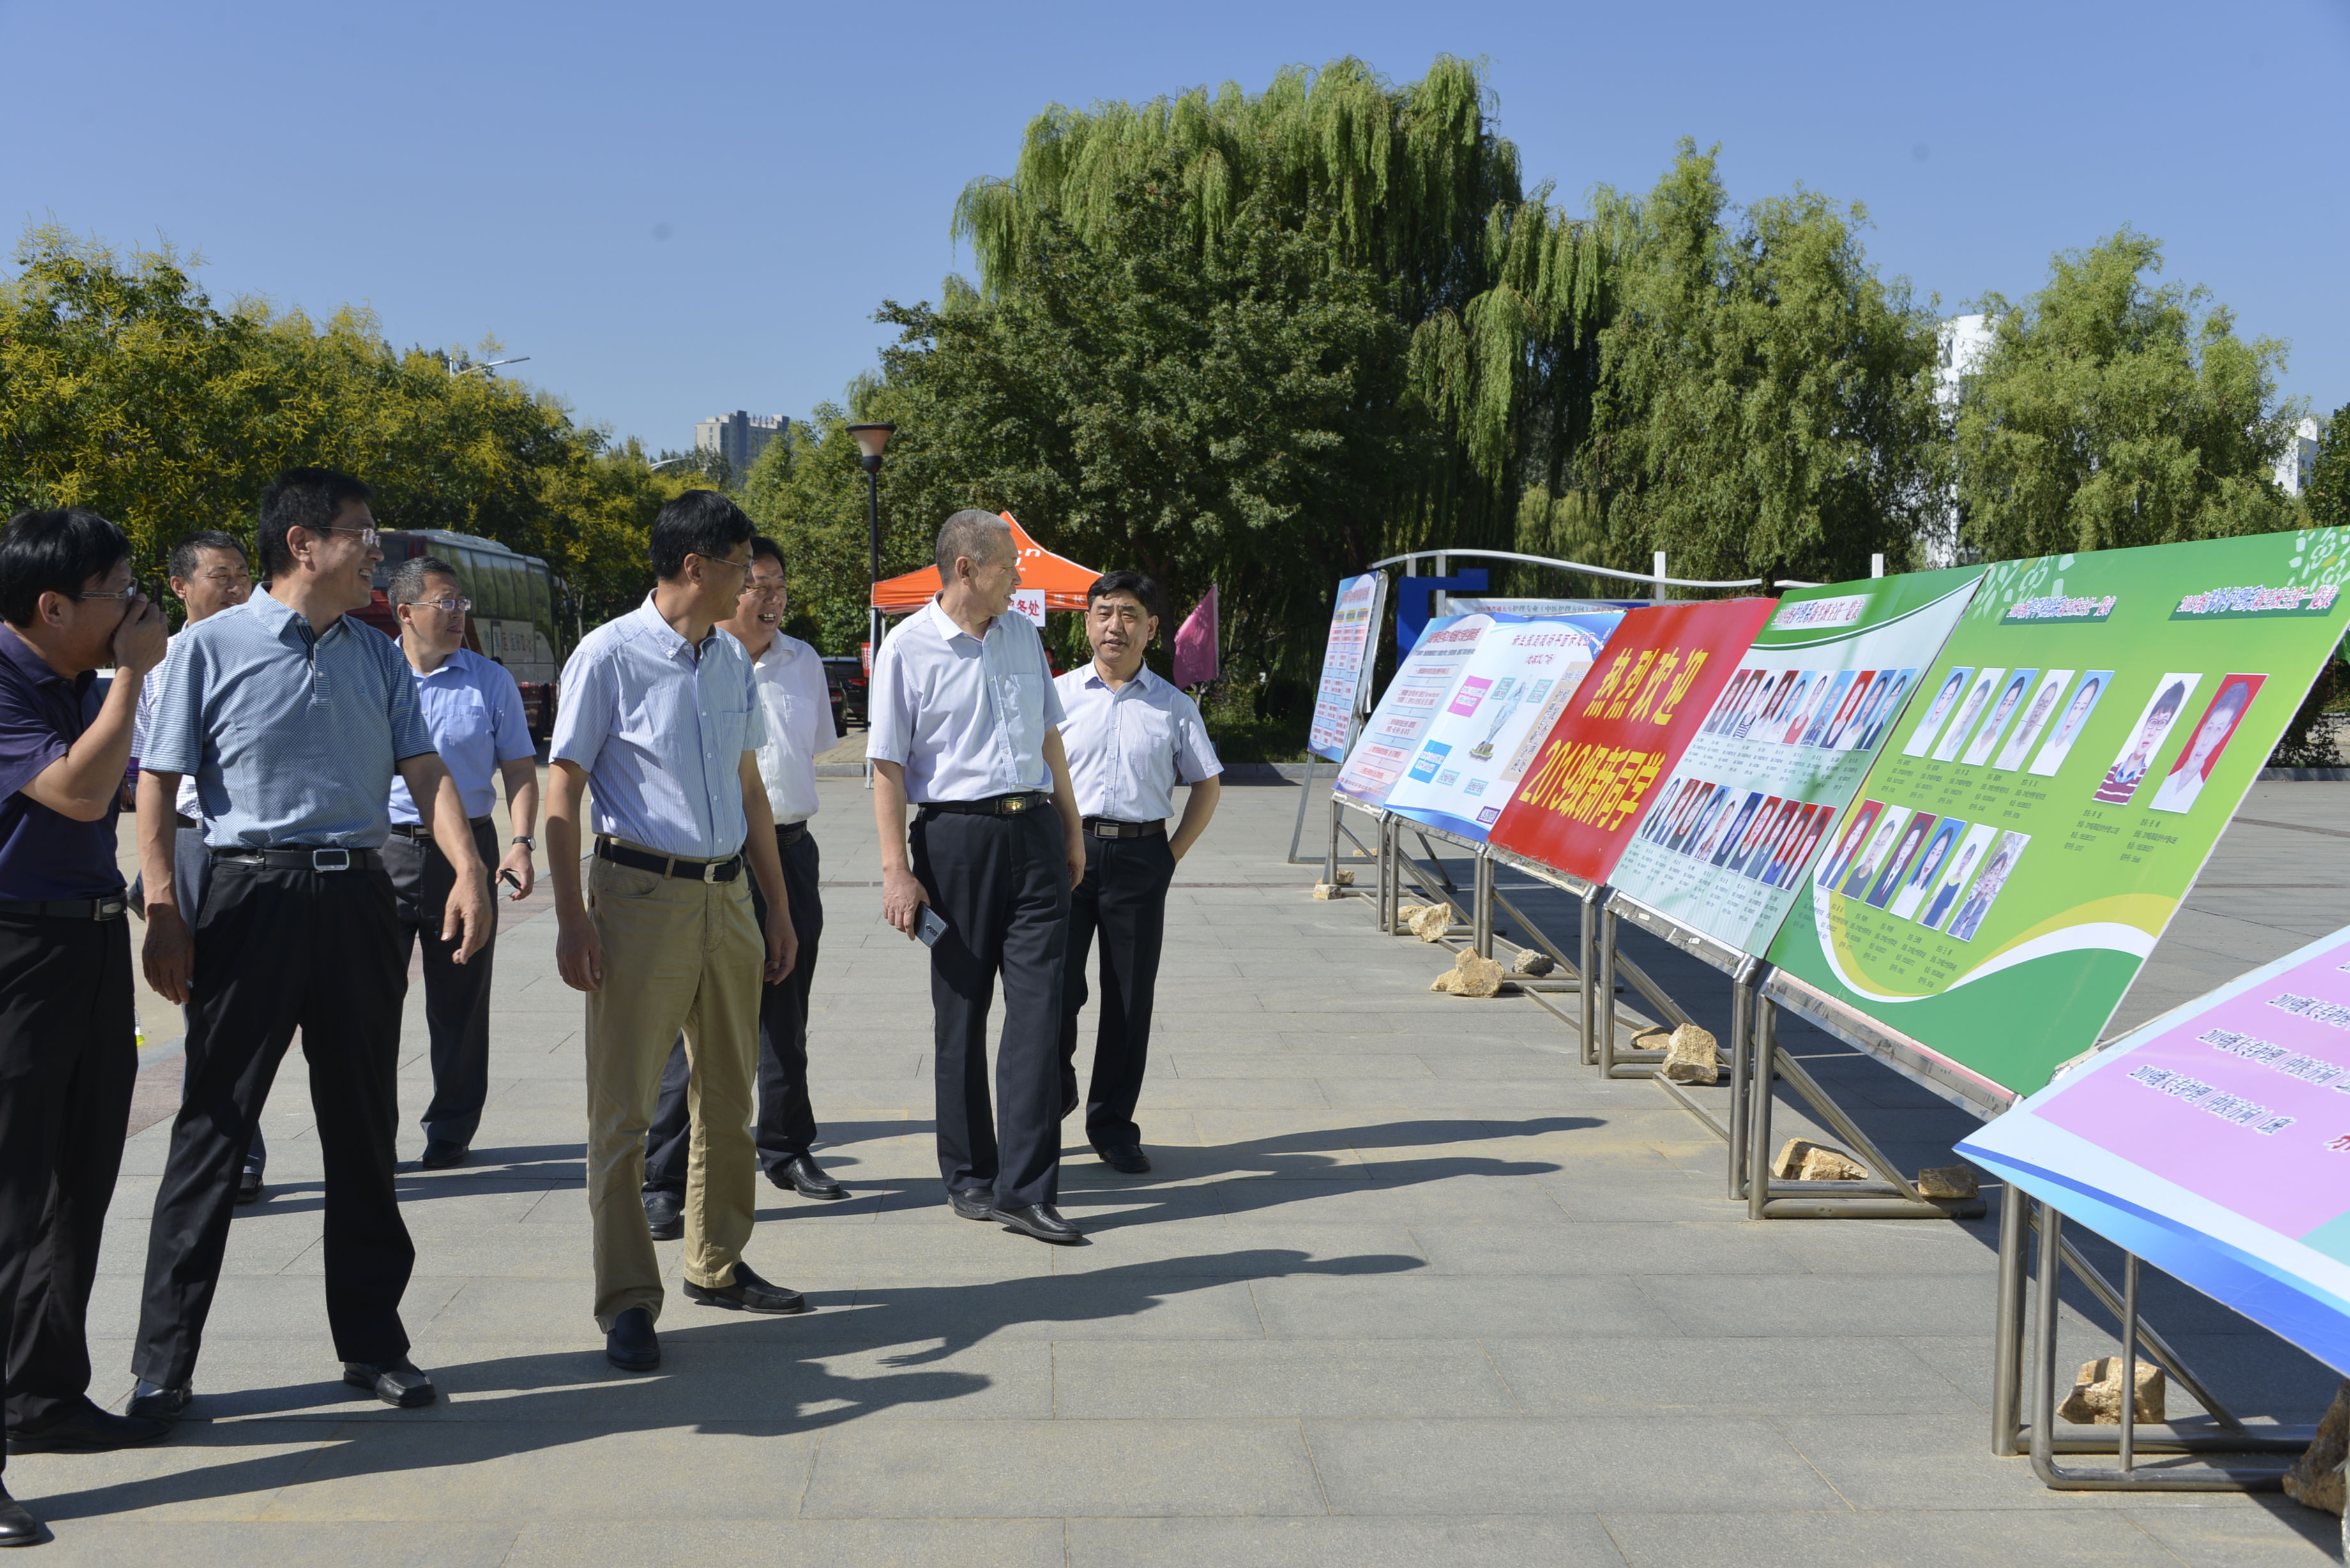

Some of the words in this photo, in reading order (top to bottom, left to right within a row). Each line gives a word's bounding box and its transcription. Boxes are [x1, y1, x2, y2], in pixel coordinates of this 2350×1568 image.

[1009, 599, 1040, 617] 务处
[1512, 633, 1595, 647] 新生报到现场平面示意图
[1582, 647, 1709, 726] 热烈欢迎
[1519, 739, 1666, 831] 2019级新同学
[2267, 993, 2350, 1029] 2019级大专护理
[2128, 1065, 2294, 1134] 2019级大专护理（中医方向）1班
